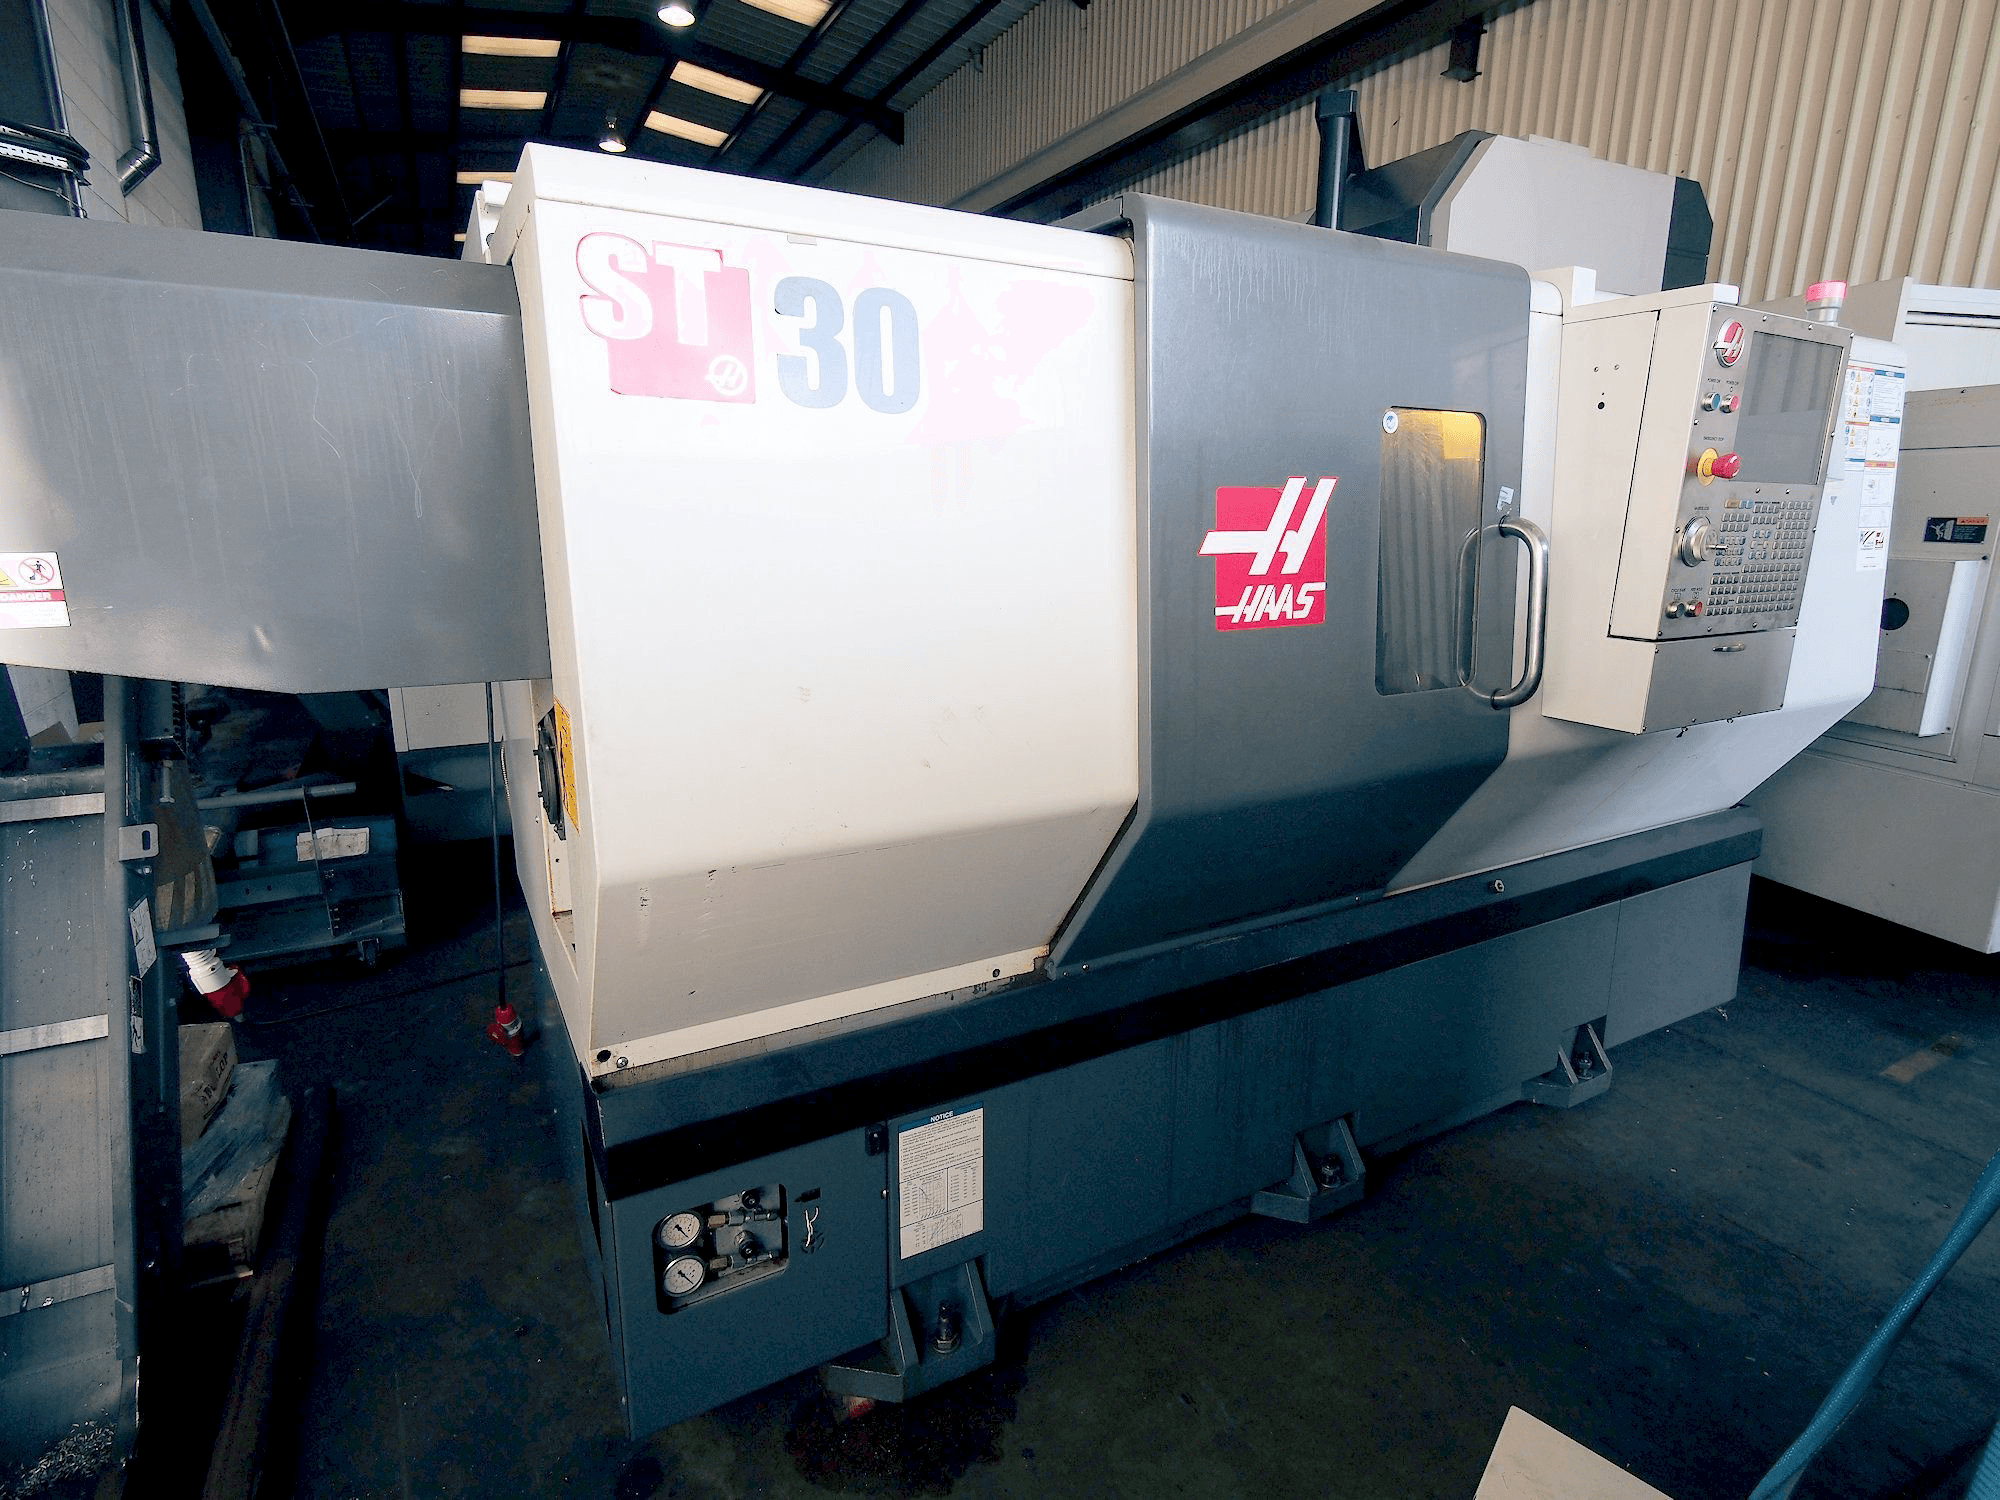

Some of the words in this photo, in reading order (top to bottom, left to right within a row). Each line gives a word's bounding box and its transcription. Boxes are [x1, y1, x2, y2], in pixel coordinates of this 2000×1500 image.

[576, 232, 723, 346] ST
[774, 276, 920, 415] 30
[1214, 582, 1327, 624] HAAS
[930, 1110, 954, 1123] NOTICE
